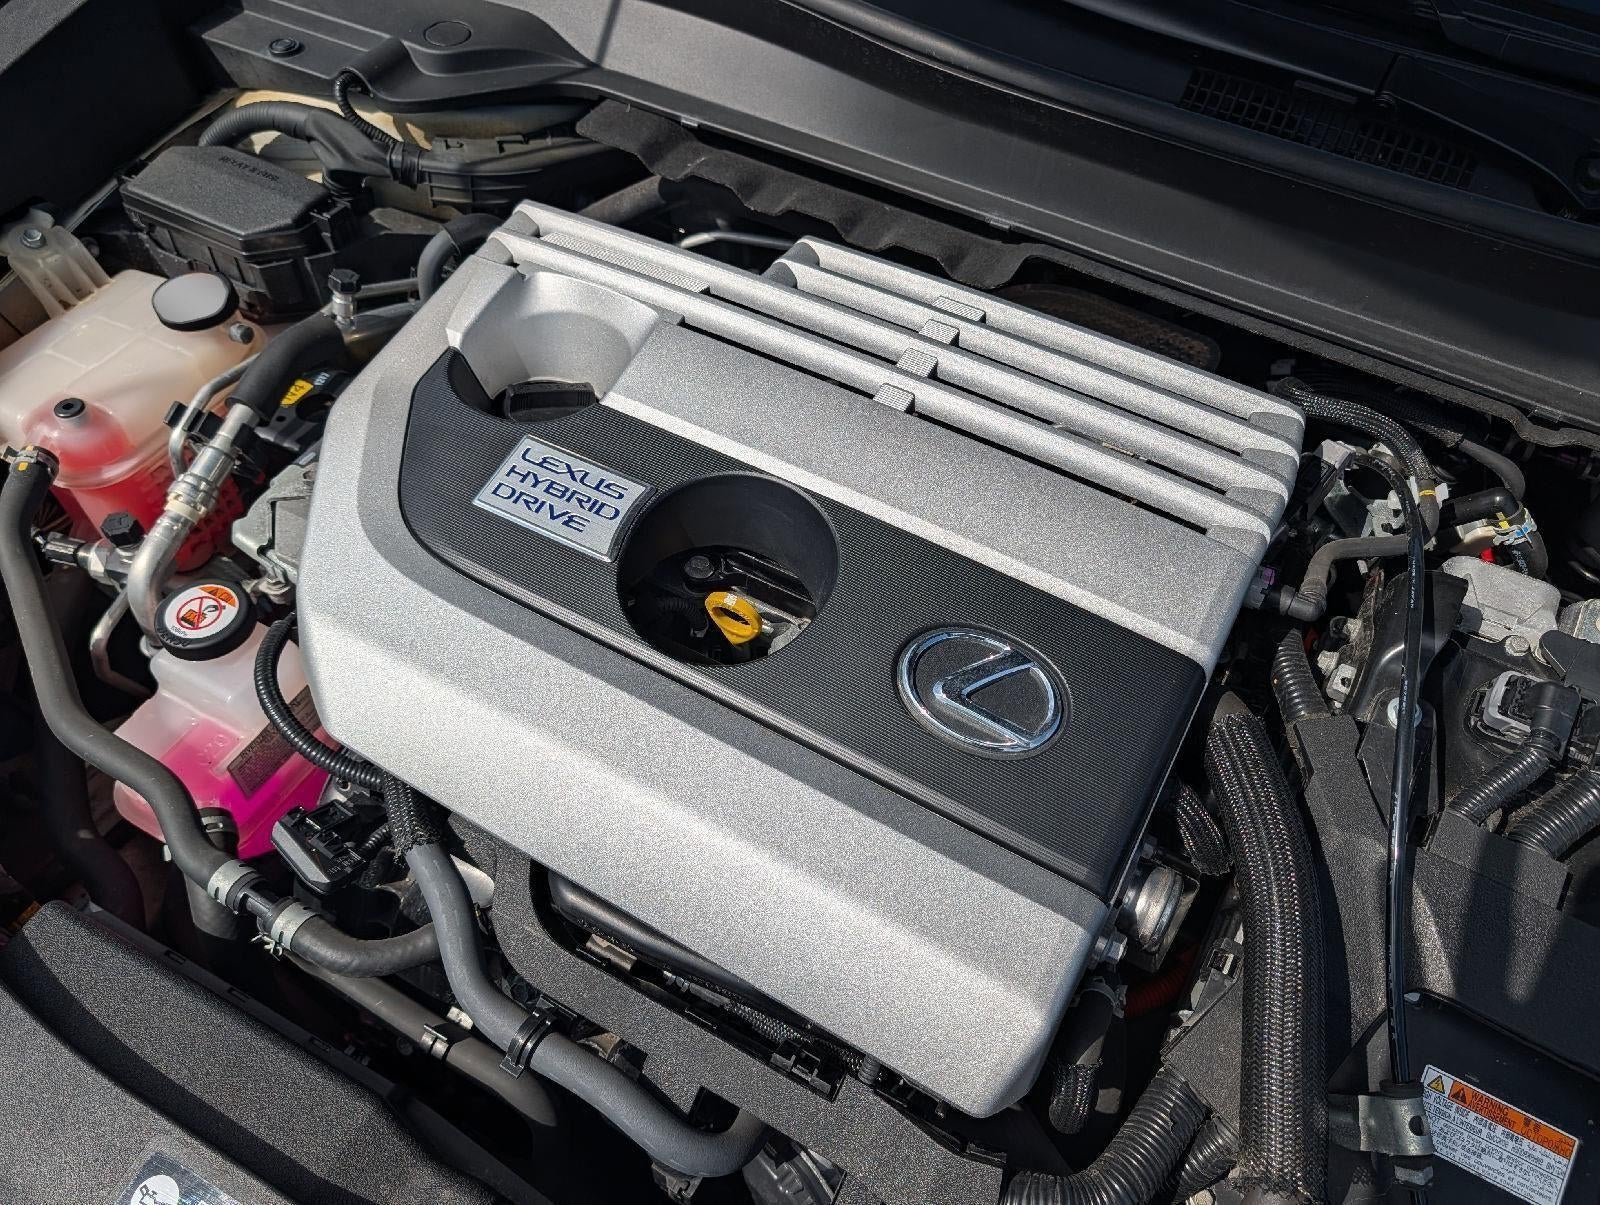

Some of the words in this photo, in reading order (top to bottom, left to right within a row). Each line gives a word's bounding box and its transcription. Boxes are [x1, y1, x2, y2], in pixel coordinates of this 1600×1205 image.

[505, 464, 621, 521] HYBRID
[521, 447, 628, 500] LEXUS
[491, 482, 591, 533] DRIVE
[1467, 1099, 1516, 1129] AVERTISSEMENT
[1470, 1090, 1509, 1117] WARNING
